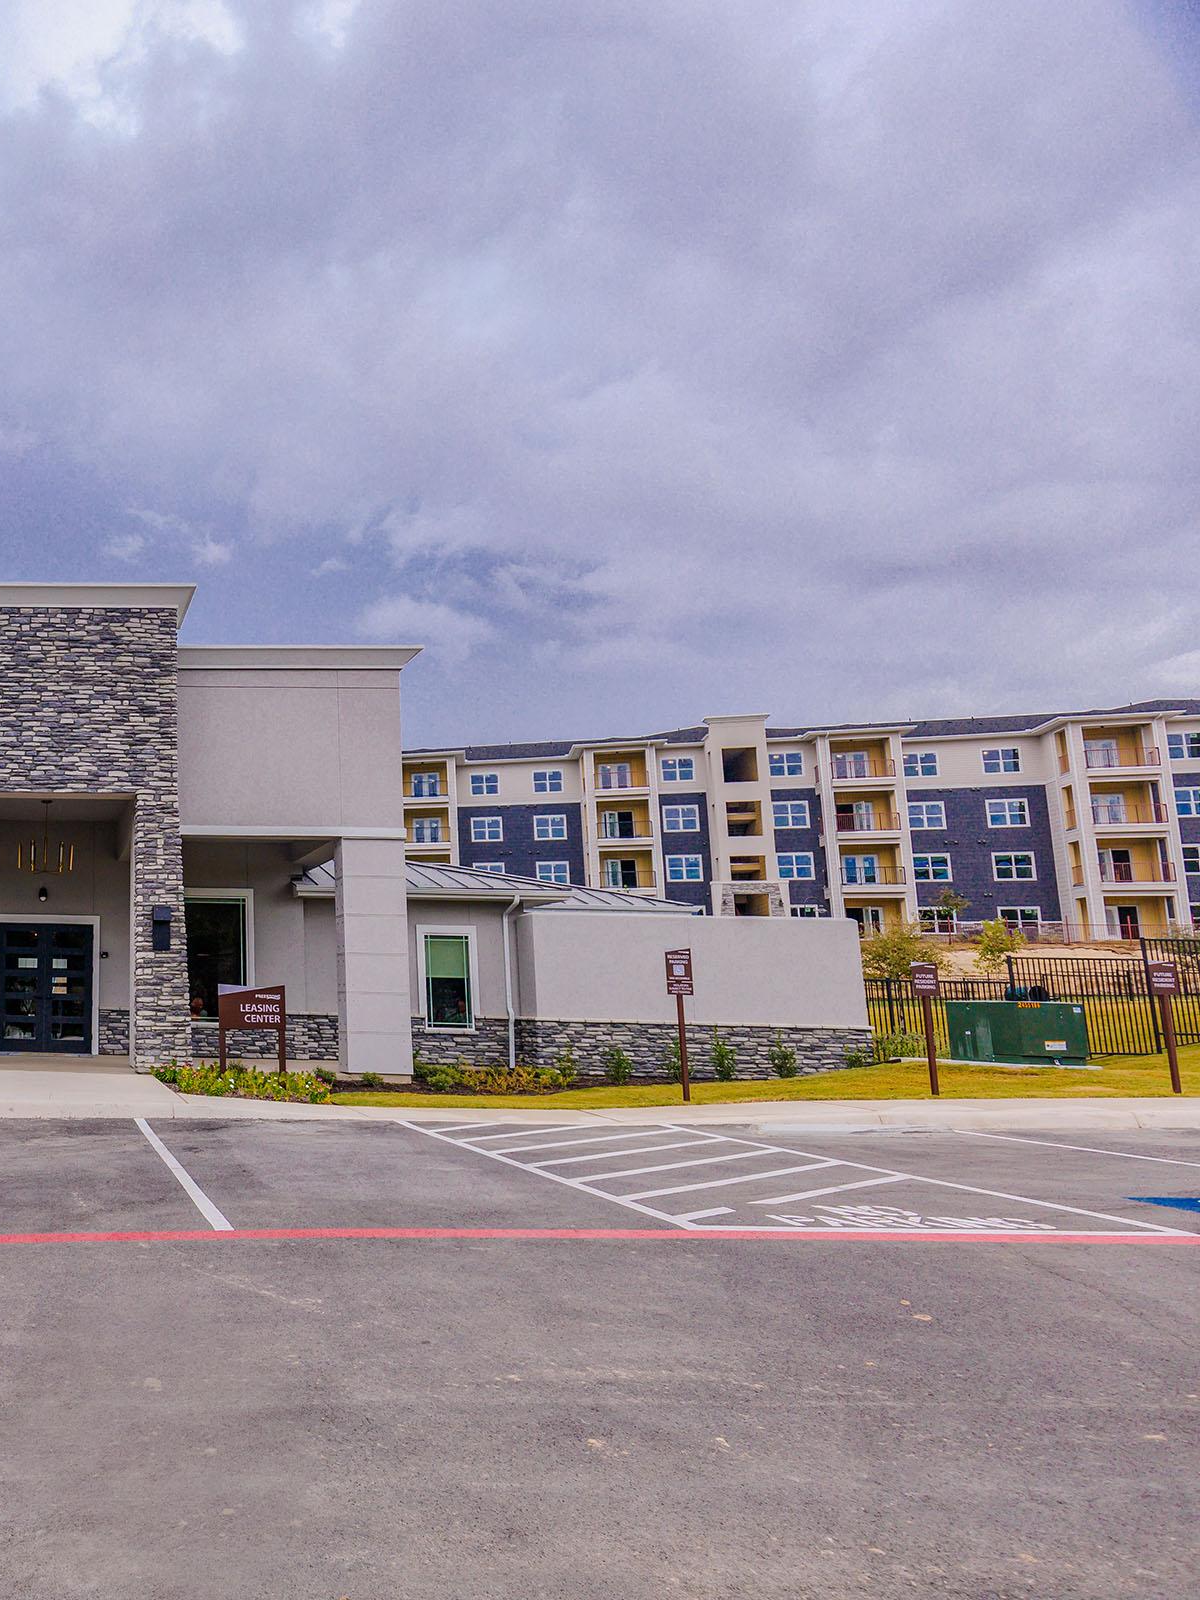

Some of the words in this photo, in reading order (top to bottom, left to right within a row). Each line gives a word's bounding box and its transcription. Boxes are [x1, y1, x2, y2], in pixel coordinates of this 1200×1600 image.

[240, 1003, 280, 1013] LEASING
[244, 1014, 281, 1023] CENTER
[810, 1205, 919, 1217] NO
[765, 1214, 1057, 1230] PARKING
